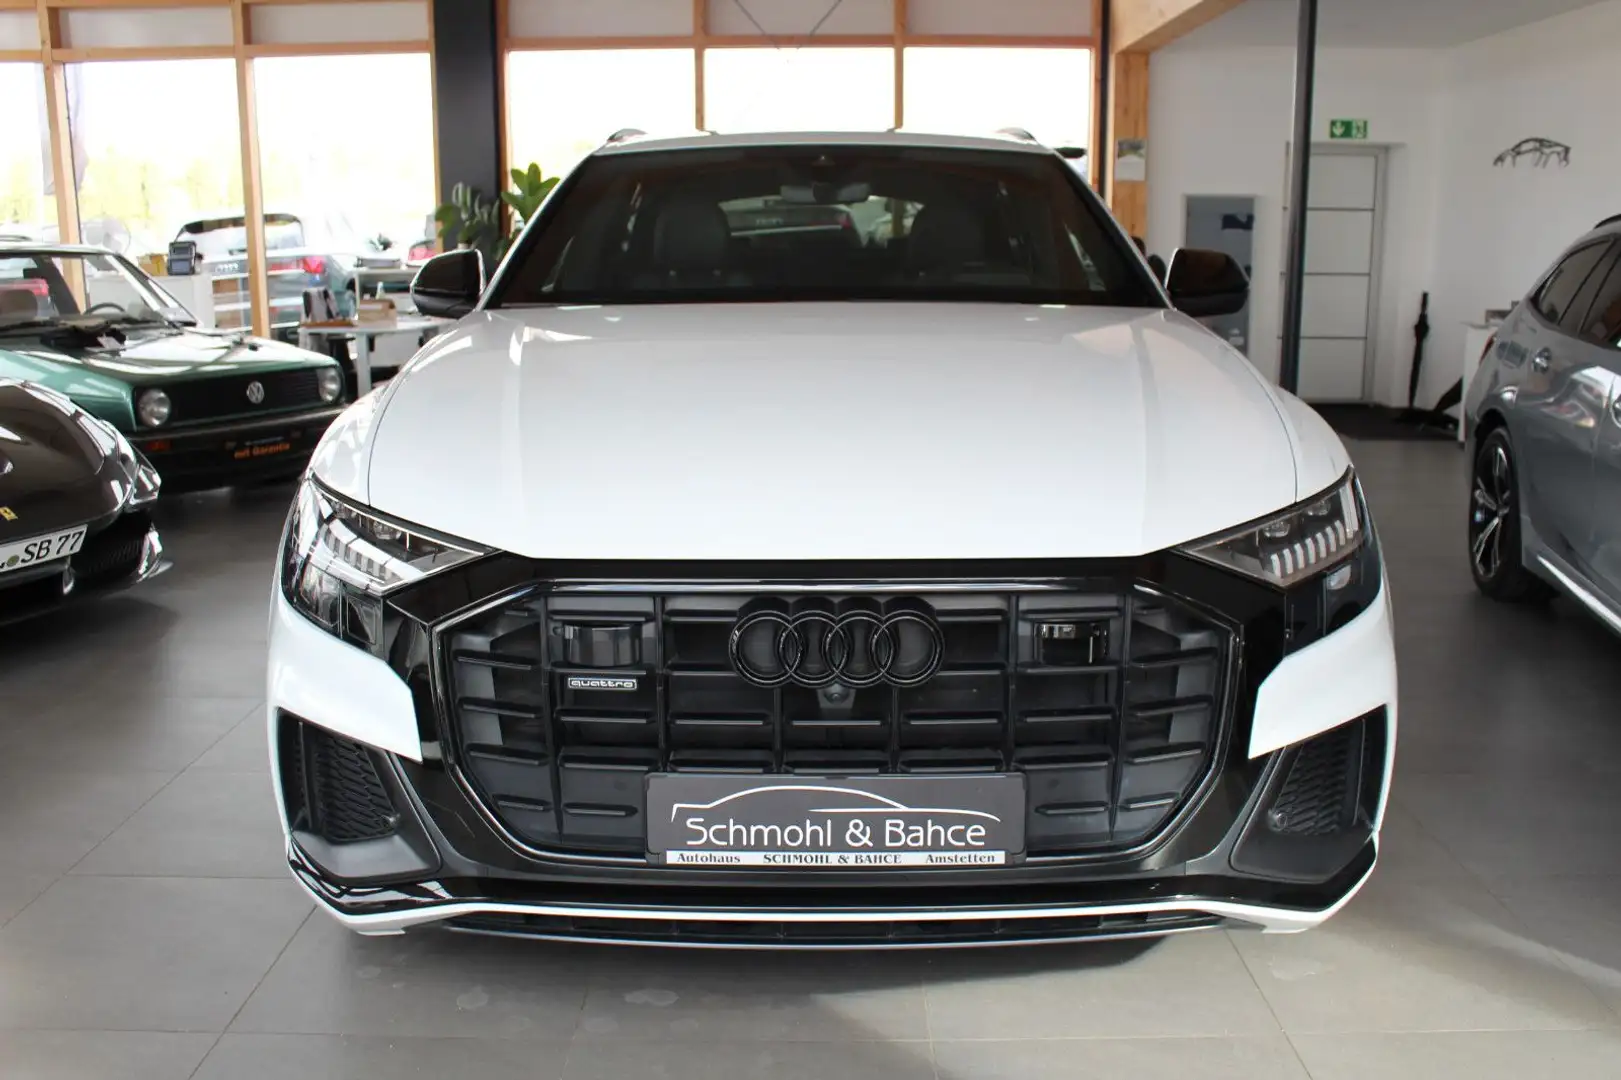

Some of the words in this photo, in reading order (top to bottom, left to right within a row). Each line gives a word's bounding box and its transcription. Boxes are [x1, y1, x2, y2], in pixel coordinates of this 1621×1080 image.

[21, 539, 52, 563] SB
[56, 530, 84, 555] 77
[686, 818, 832, 847] Schmohl
[845, 819, 874, 847] &
[885, 819, 986, 847] Bahce
[677, 853, 741, 863] Autohaus
[763, 854, 832, 864] SCHMOHL
[837, 854, 850, 864] &
[854, 854, 902, 864] BAHCE
[926, 853, 995, 863] Amstetten
